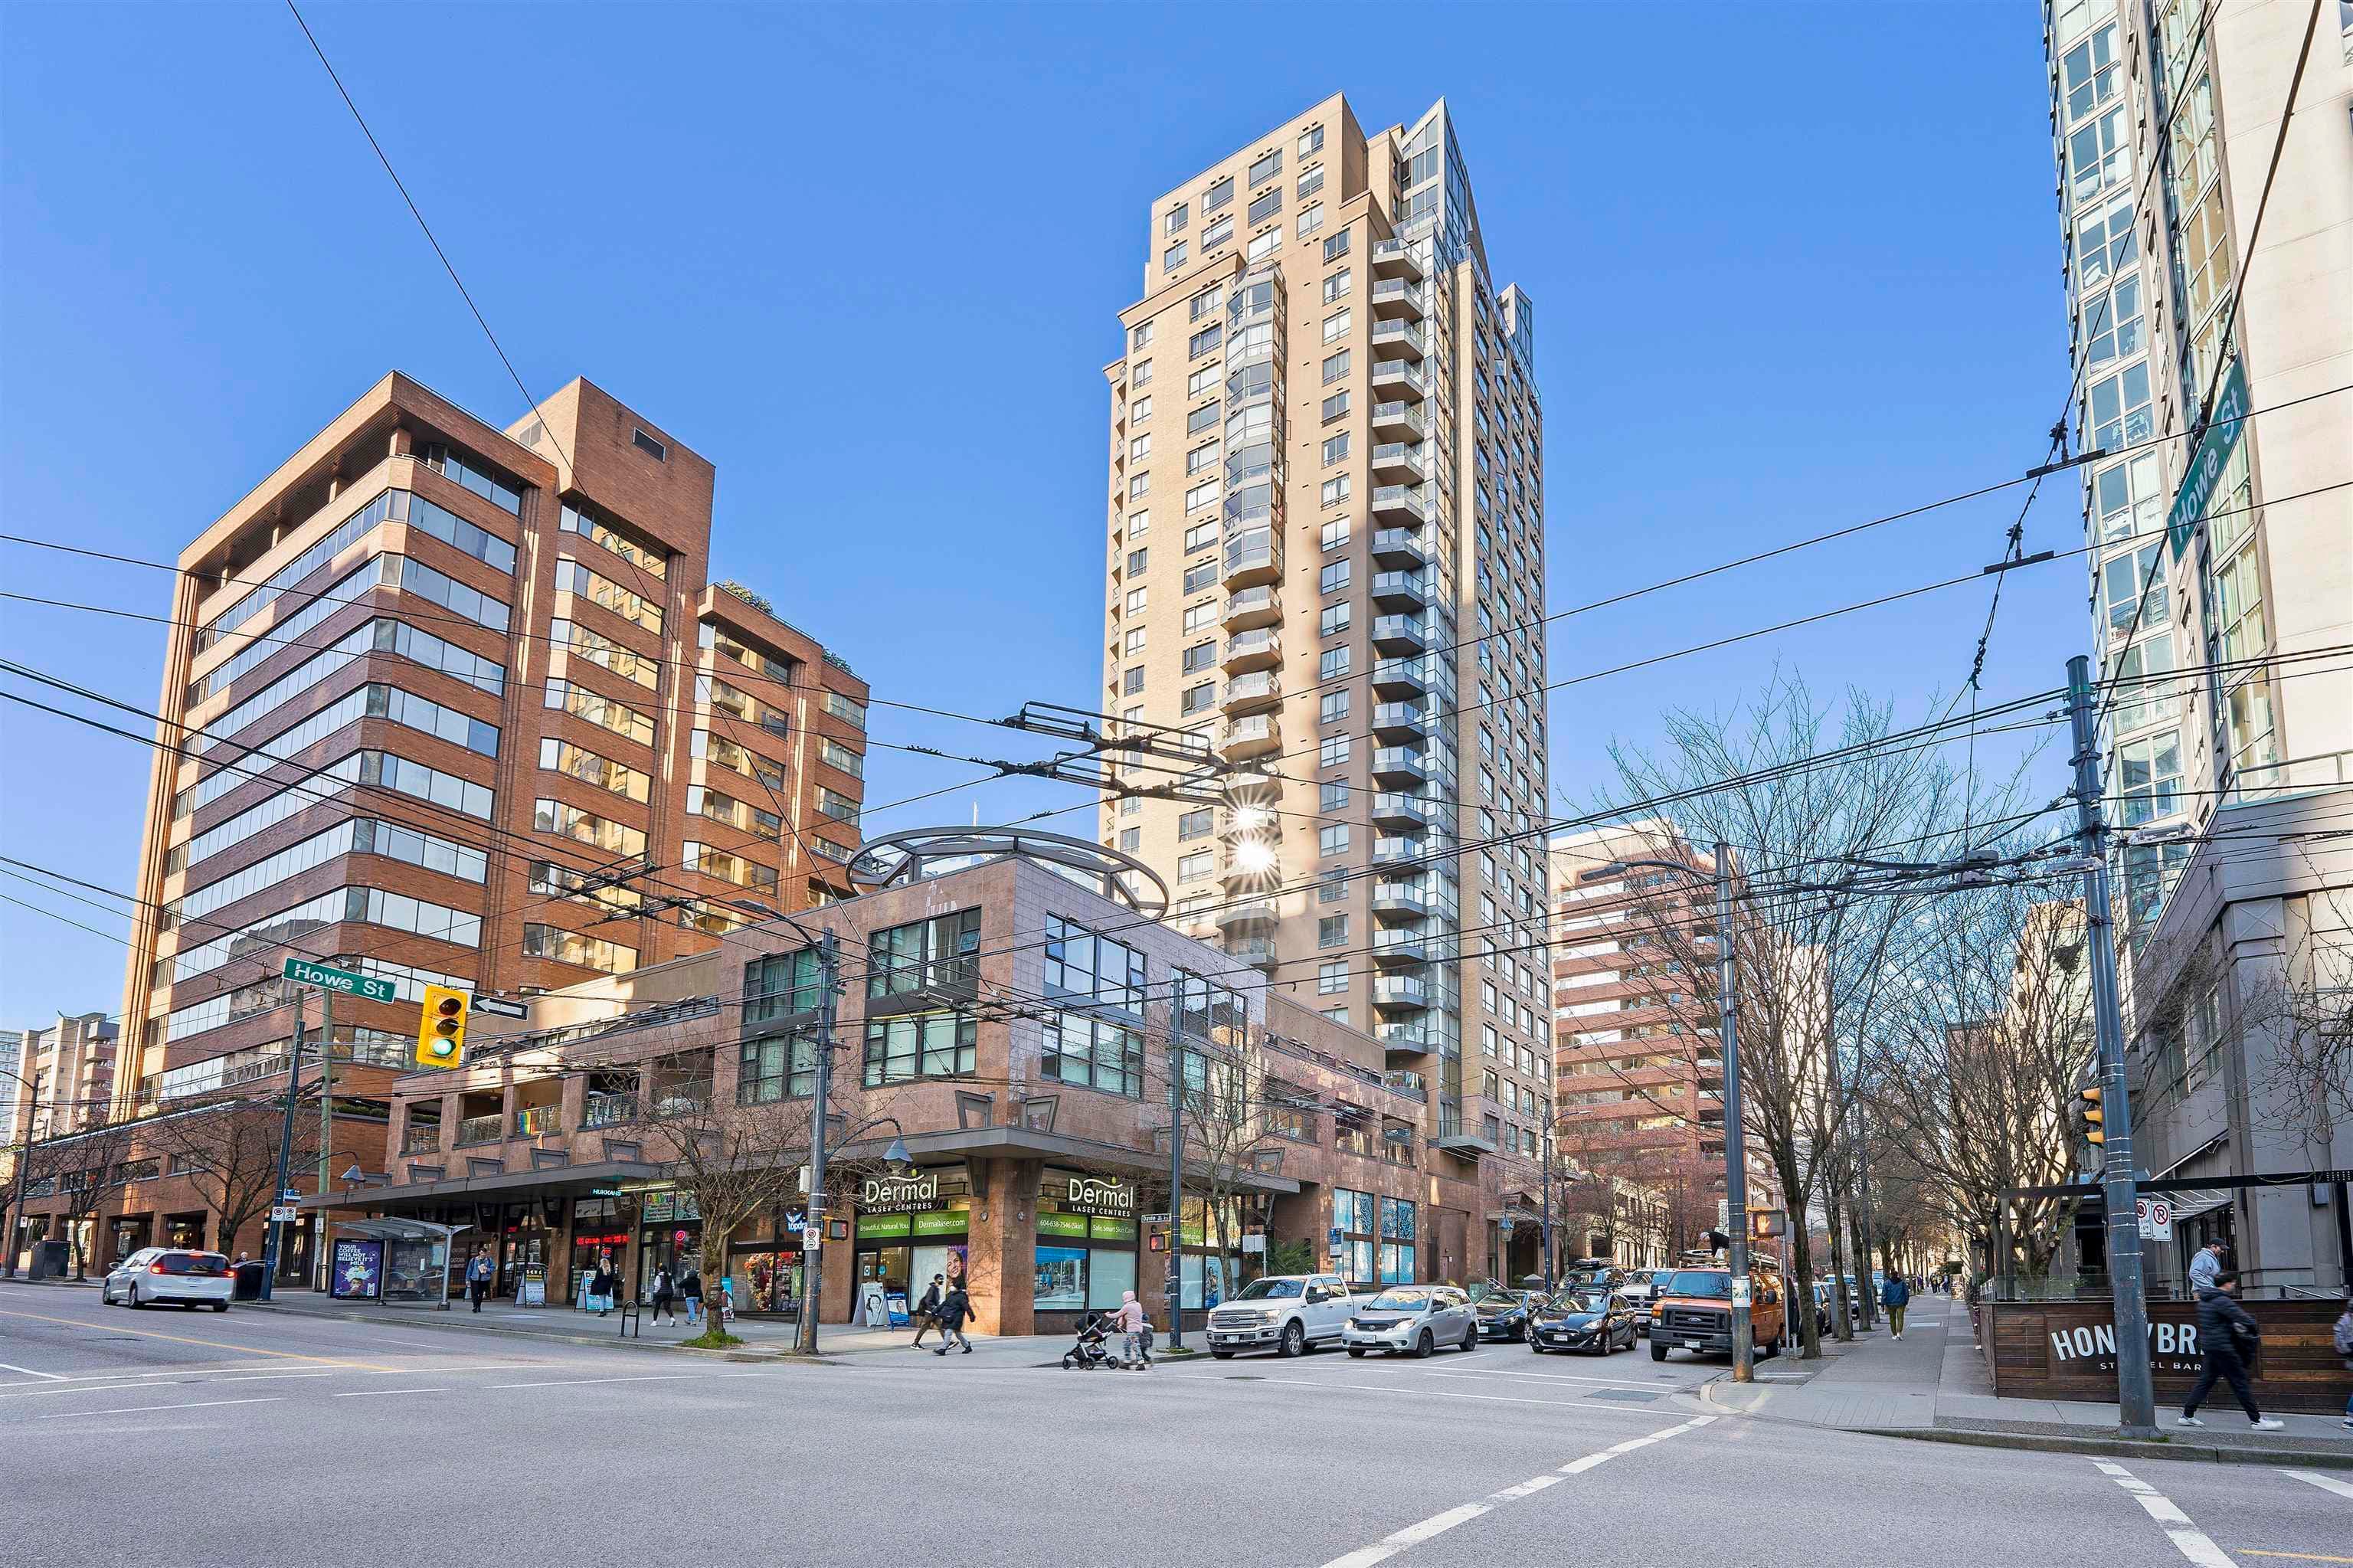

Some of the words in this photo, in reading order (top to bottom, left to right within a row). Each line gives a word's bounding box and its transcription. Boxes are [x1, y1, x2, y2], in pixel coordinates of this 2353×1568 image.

[2175, 447, 2218, 544] Howe
[2220, 386, 2242, 445] St
[294, 963, 354, 990] Howe
[362, 980, 386, 997] St
[865, 1174, 938, 1203] Dermal
[1069, 1178, 1134, 1208] Dermal
[895, 1202, 932, 1211] CENTRES
[1072, 1205, 1095, 1213] LASER
[1099, 1208, 1131, 1217] CENTRES
[2173, 1362, 2202, 1371] BAR
